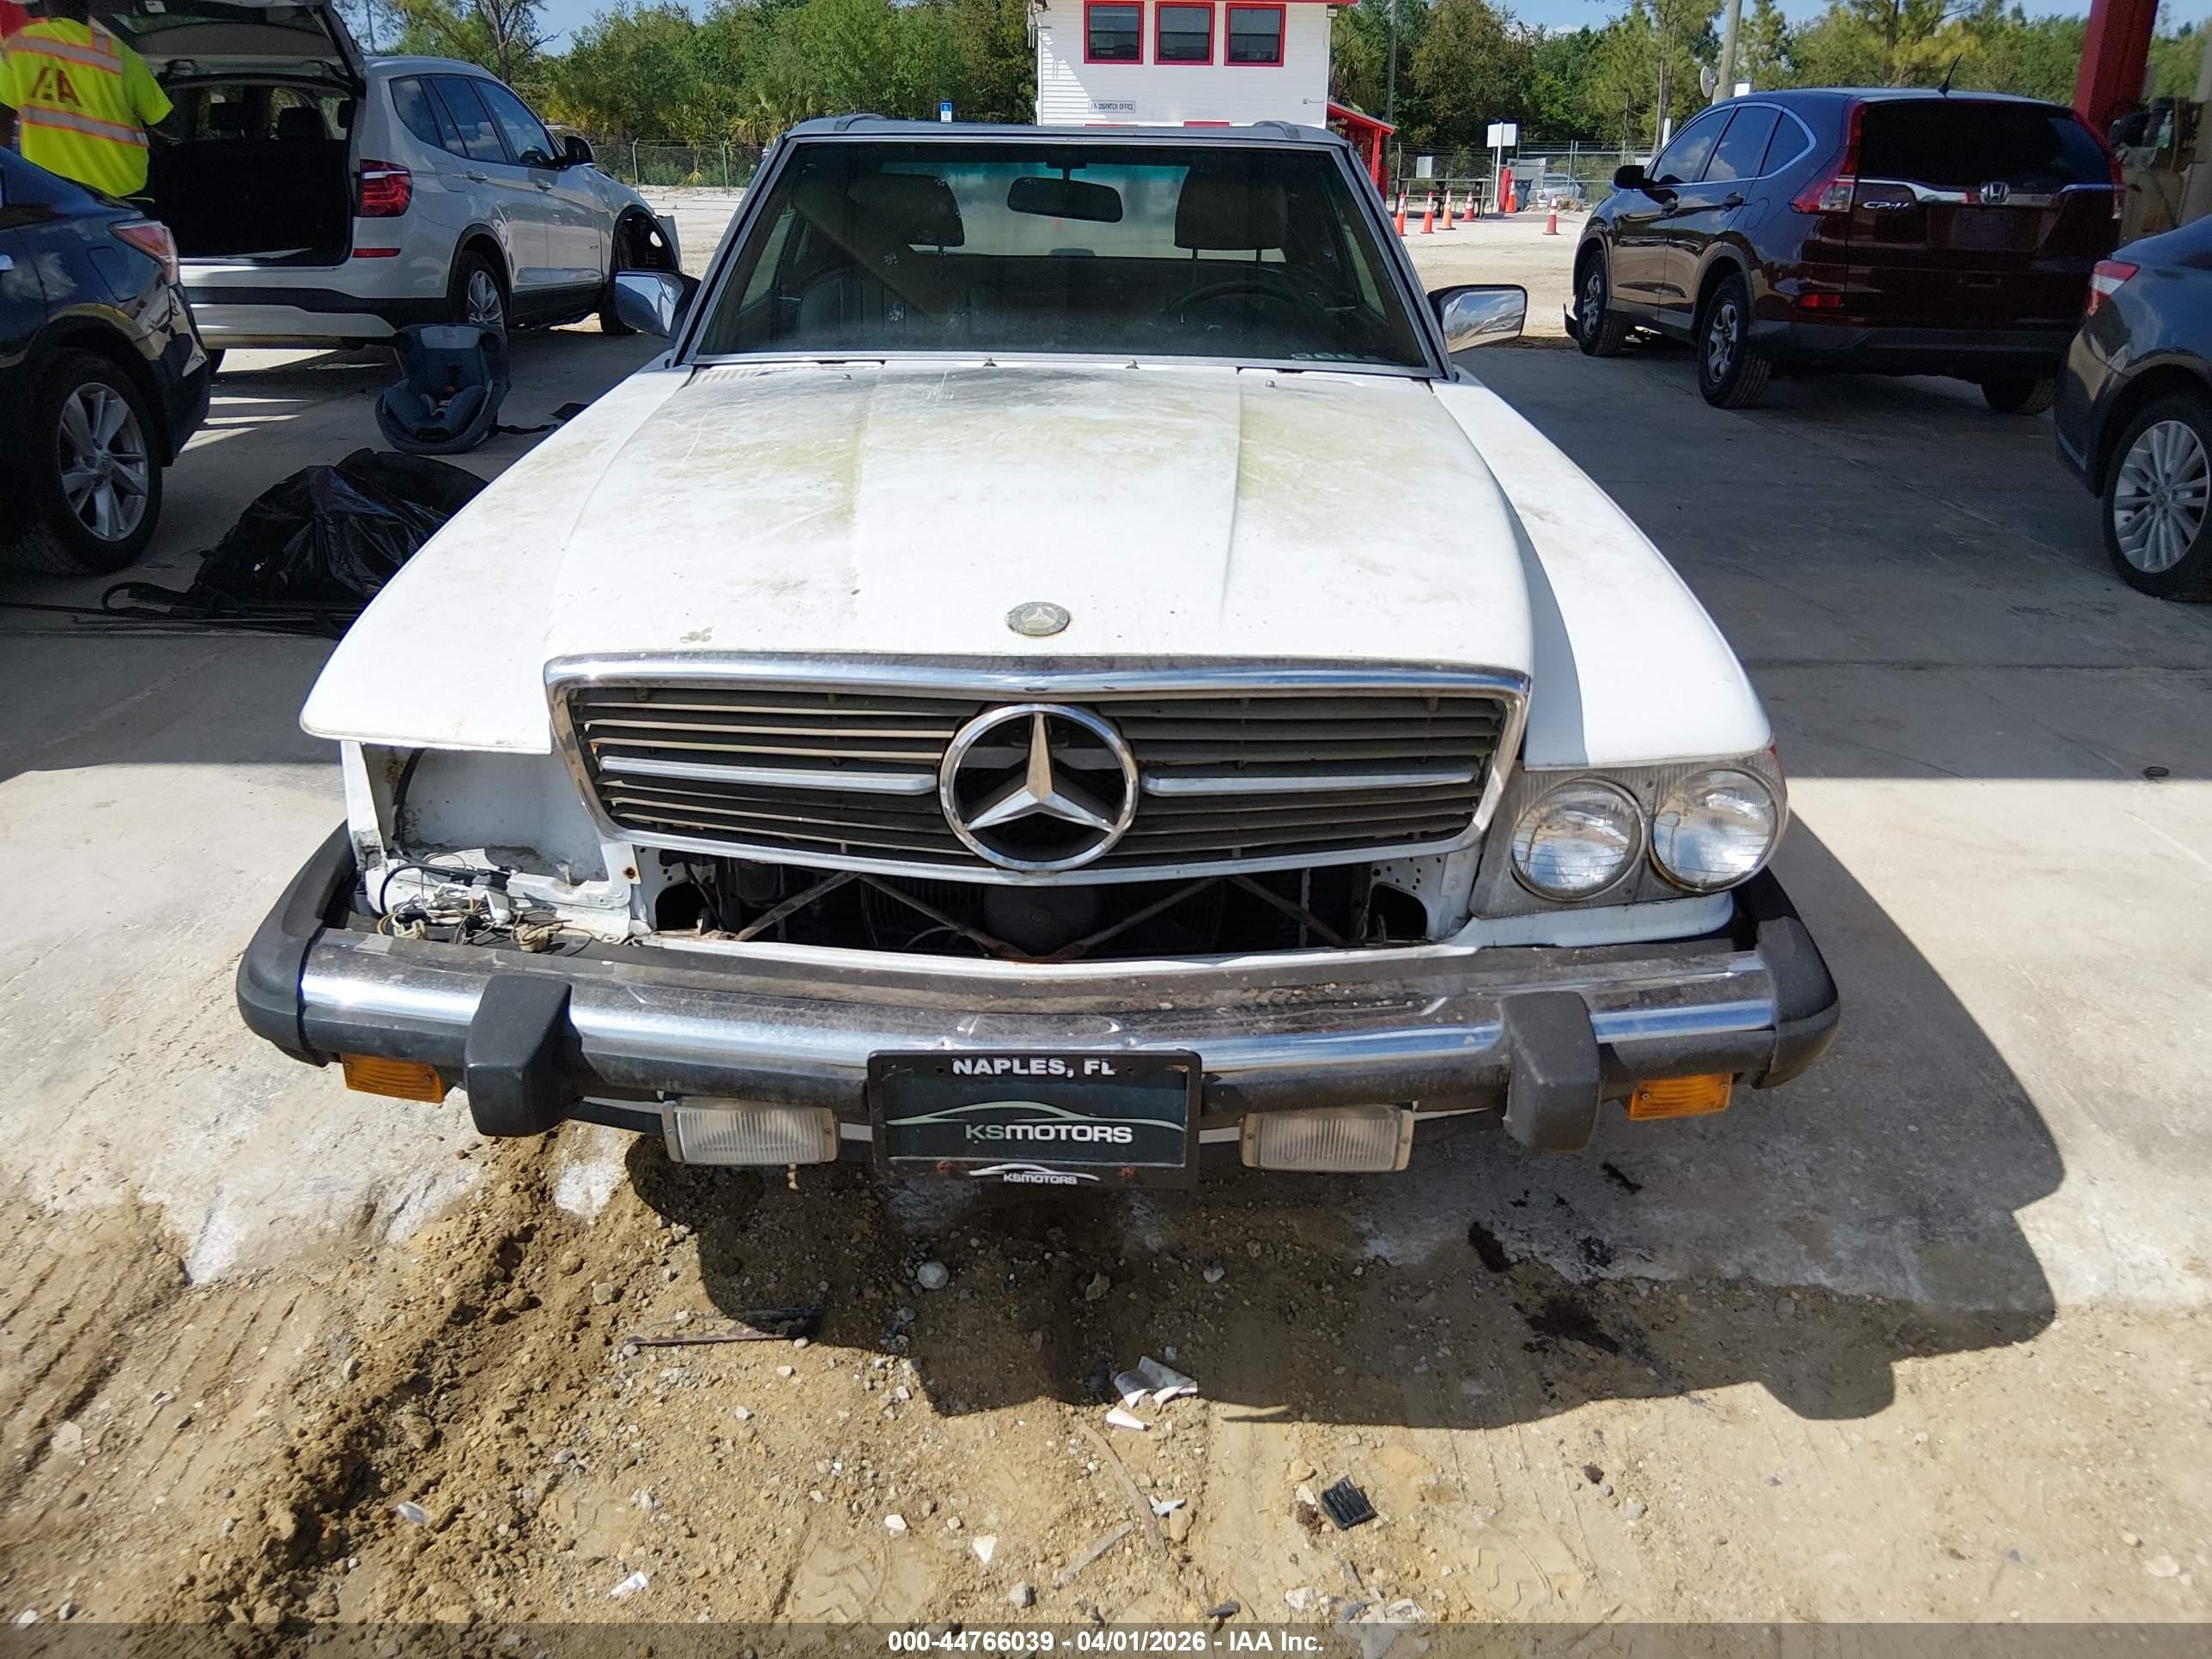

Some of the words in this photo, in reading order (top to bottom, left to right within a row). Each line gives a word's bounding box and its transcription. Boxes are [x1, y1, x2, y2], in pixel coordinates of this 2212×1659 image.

[951, 1057, 1074, 1079] NAPLES,
[1083, 1057, 1116, 1075] FL
[965, 1123, 1133, 1144] KSMOTORS
